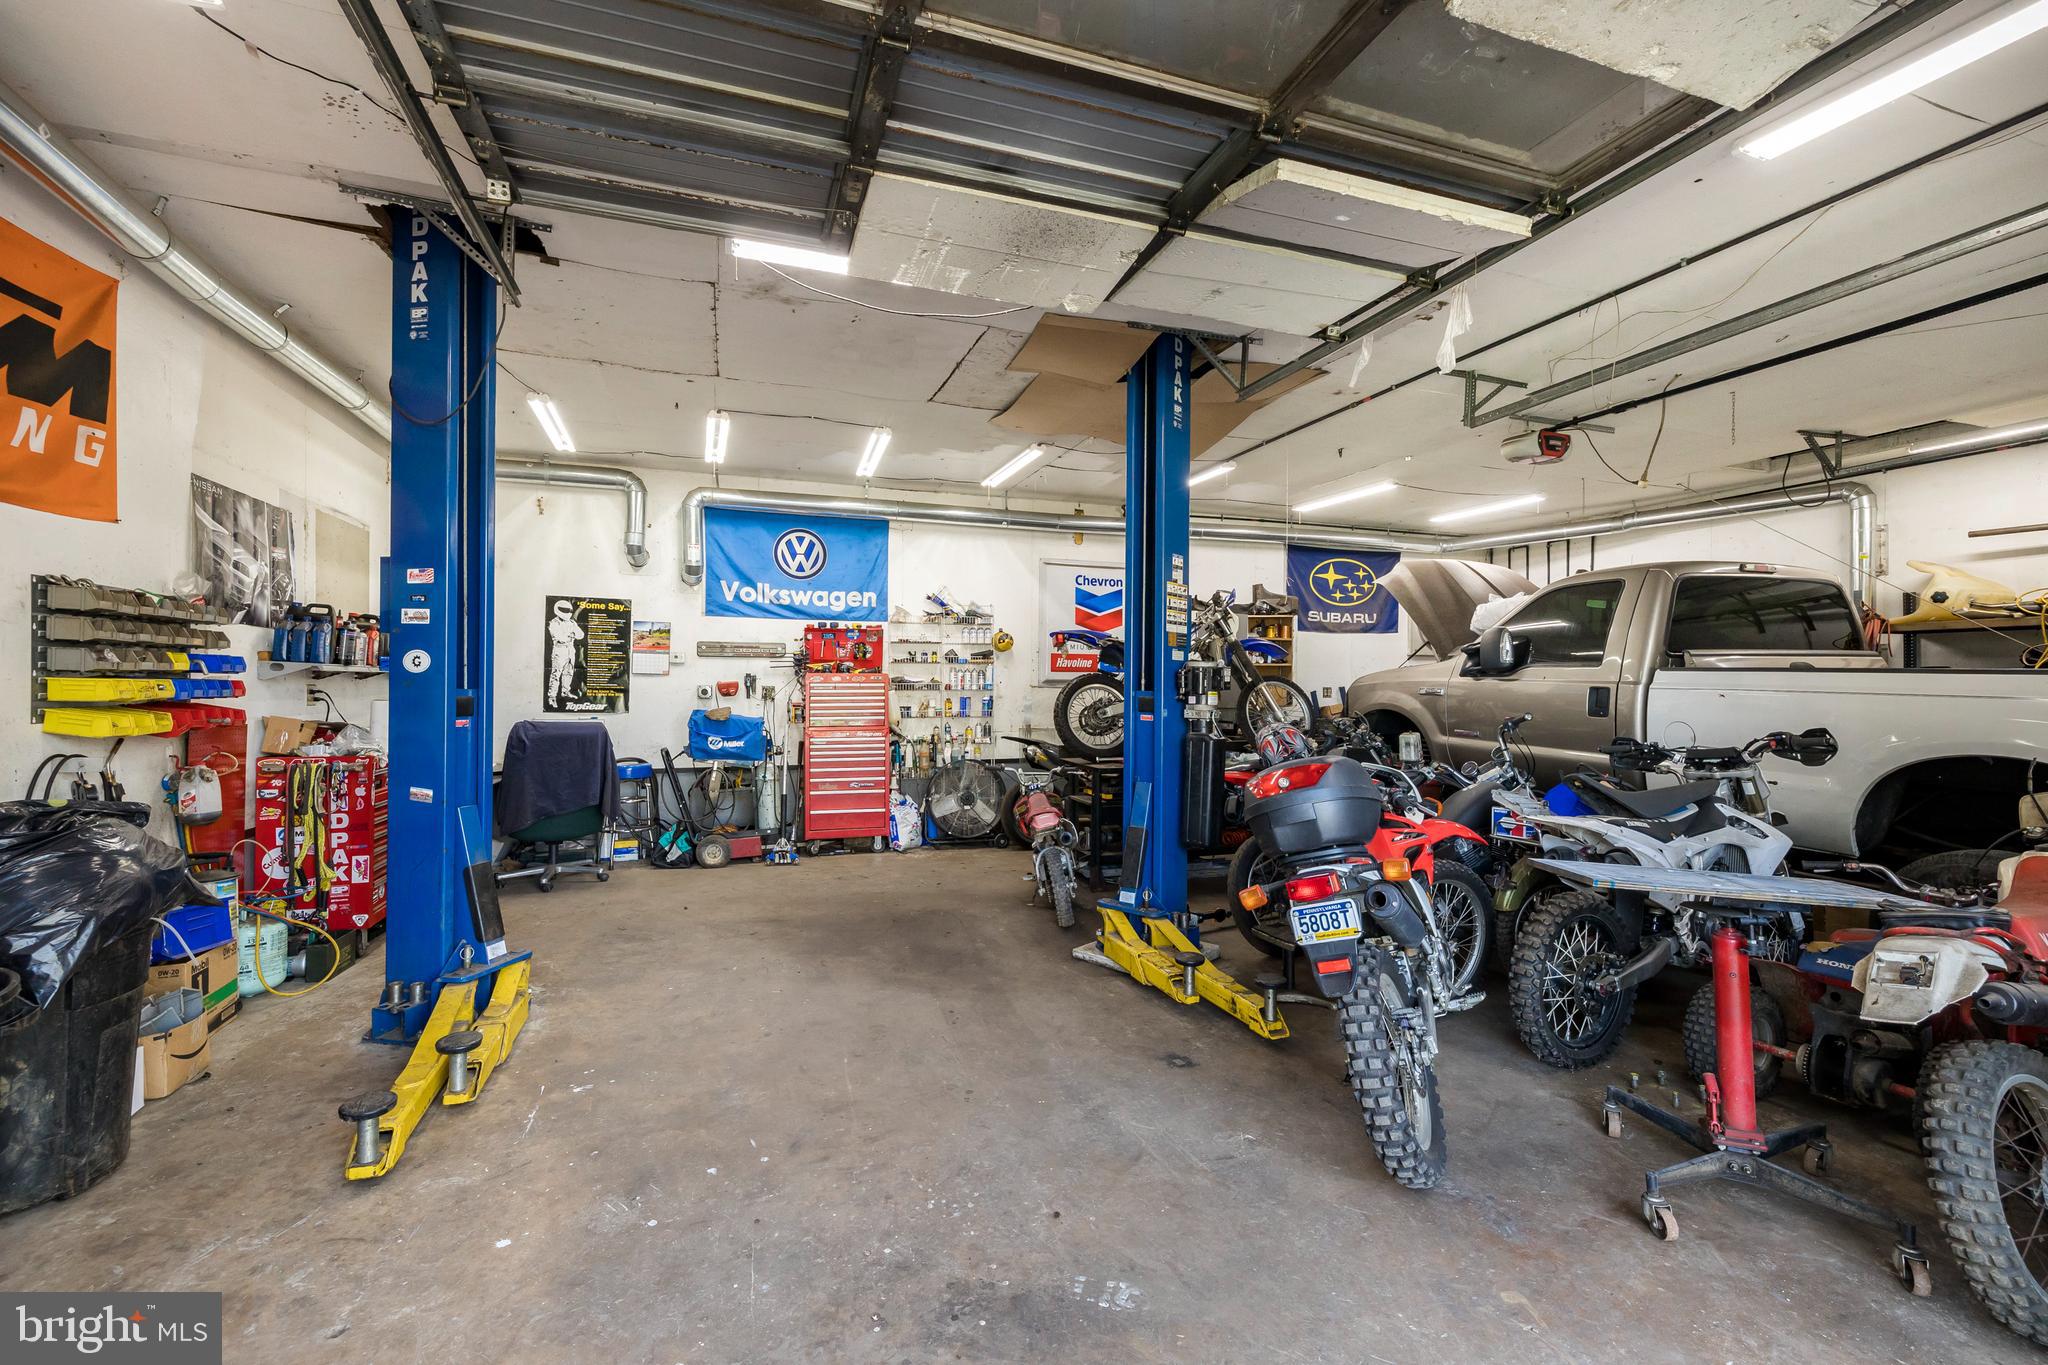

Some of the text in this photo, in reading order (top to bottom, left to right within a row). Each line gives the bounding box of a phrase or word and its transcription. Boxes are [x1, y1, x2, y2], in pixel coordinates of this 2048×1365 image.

[411, 207, 429, 303] DPAK
[1174, 334, 1184, 404] DPAK
[193, 478, 223, 496] NISSAN
[1075, 575, 1123, 587] Chevron
[720, 580, 877, 612] Volkswagen
[1307, 610, 1377, 624] SUBARU
[1056, 658, 1093, 668] Havoline
[565, 702, 607, 711] TopGear
[723, 740, 745, 748] Miller
[1302, 904, 1342, 915] PENNSYLVANIA
[1299, 909, 1350, 935] 5808T
[191, 958, 209, 975] Mobil
[1816, 957, 1855, 971] HON
[157, 968, 180, 977] 0W-20
